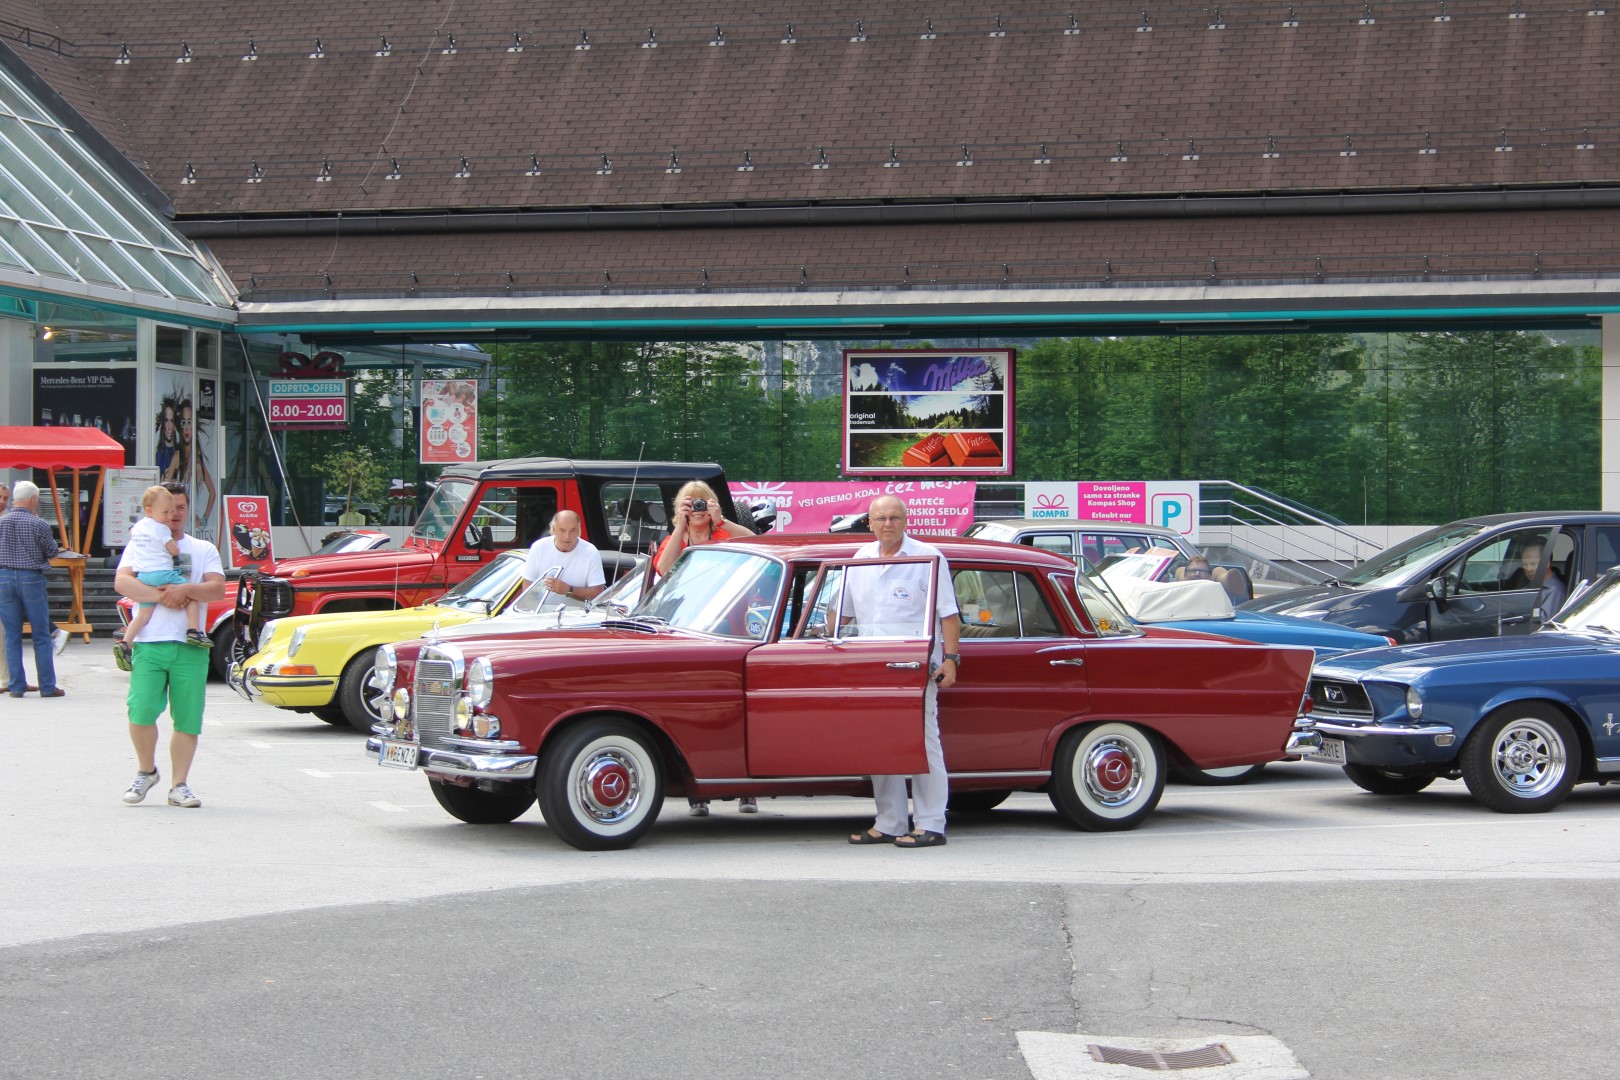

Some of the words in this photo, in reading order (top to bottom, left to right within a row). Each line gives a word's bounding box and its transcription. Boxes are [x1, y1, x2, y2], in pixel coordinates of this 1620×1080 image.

[923, 357, 990, 391] Milka
[40, 376, 86, 385] Mercedes-Benz
[87, 375, 99, 384] VIP
[274, 383, 341, 393] ODPRTO-OFFEN
[849, 412, 876, 421] original
[798, 498, 814, 508] VSI
[816, 492, 853, 505] GREMO
[854, 487, 880, 499] KDAJ
[908, 497, 945, 506] RATEČE
[906, 508, 936, 516] ENSKO
[938, 507, 969, 516] SEDLO
[1032, 510, 1069, 518] KOMPAS
[1162, 501, 1182, 528] P
[907, 518, 947, 527] LJUBELJ
[907, 528, 957, 536] ARAVANKE
